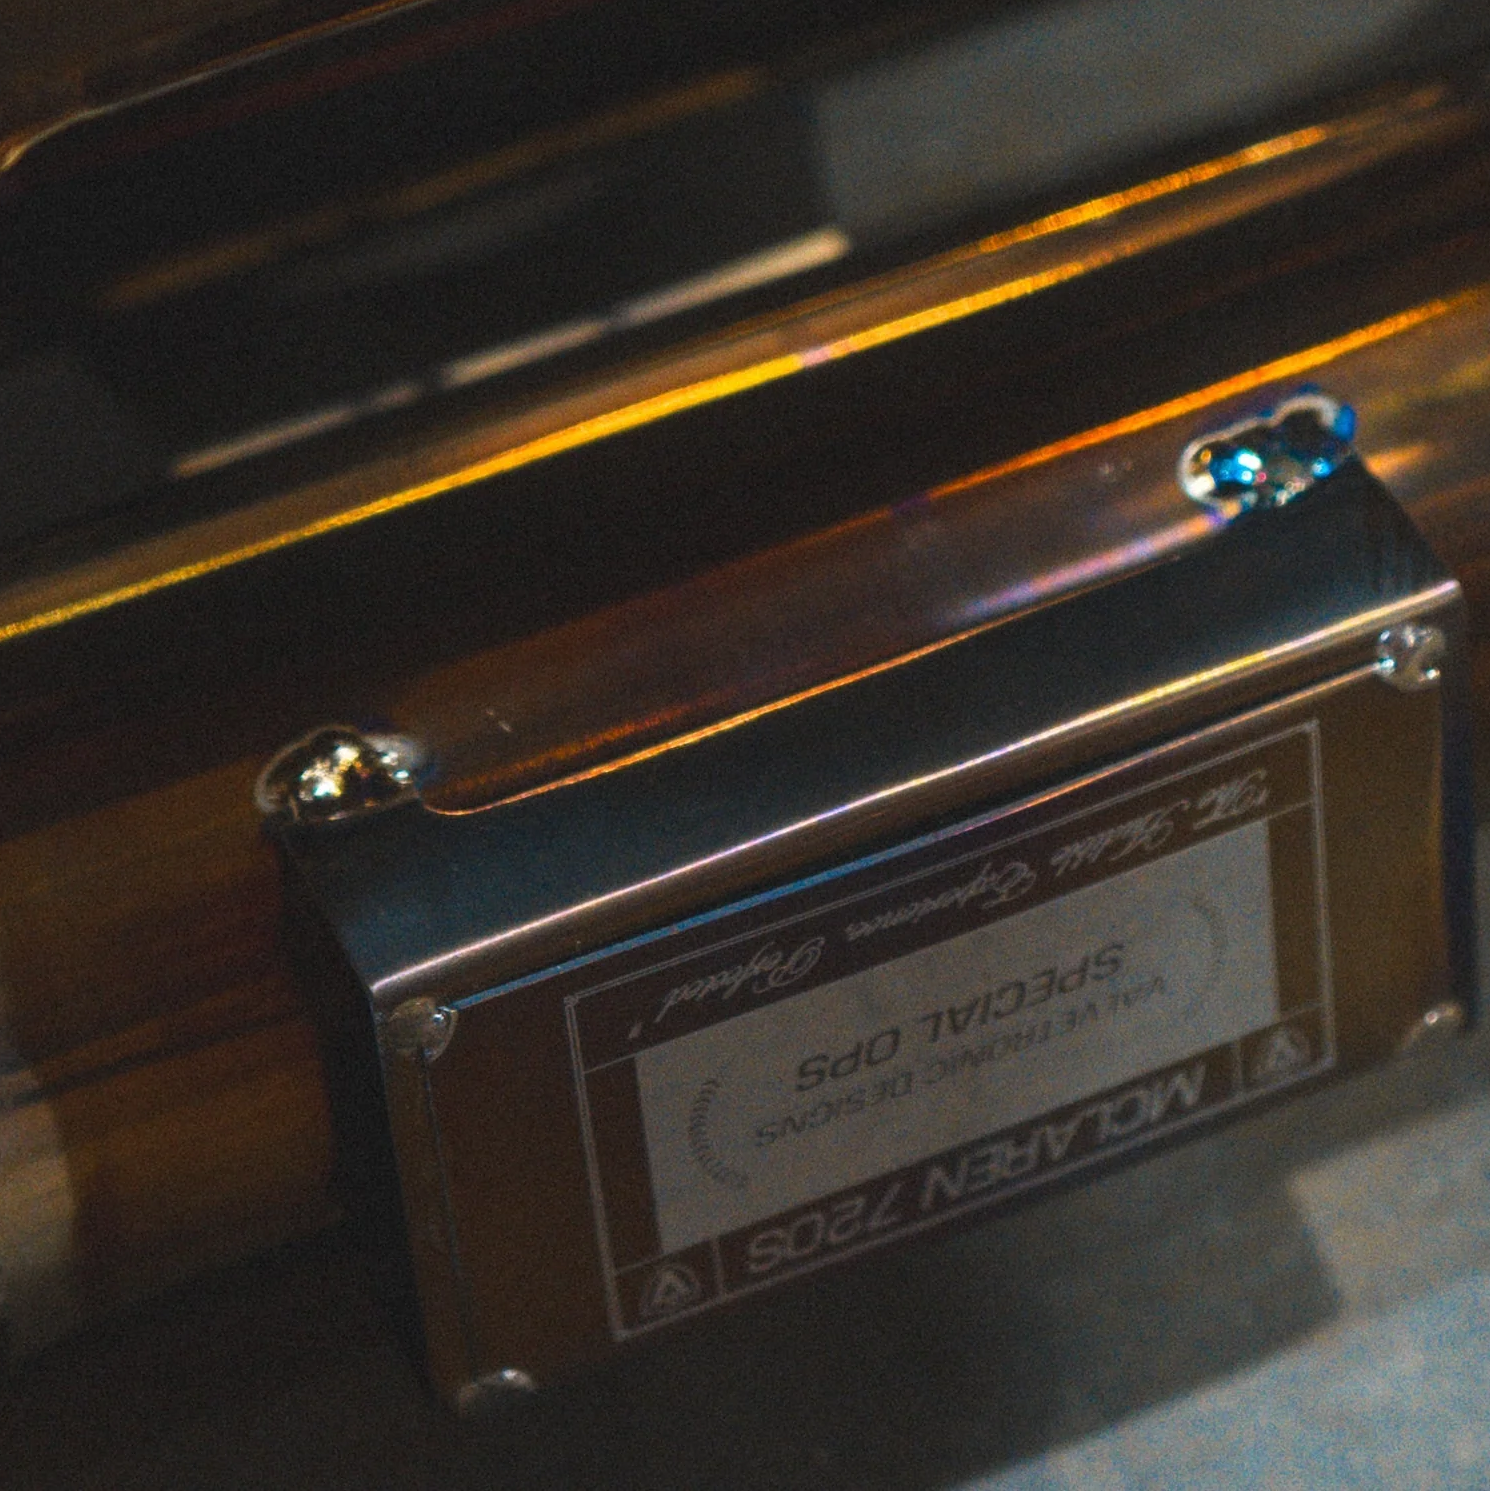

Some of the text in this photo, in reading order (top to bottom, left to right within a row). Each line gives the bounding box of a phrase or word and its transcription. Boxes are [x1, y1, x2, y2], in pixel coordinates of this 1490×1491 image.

[791, 940, 1126, 1092] SPECIAL OPS
[926, 976, 1166, 1085] VALVETRONIC
[753, 1067, 914, 1151] DESIGNS
[748, 1182, 906, 1274] 720S
